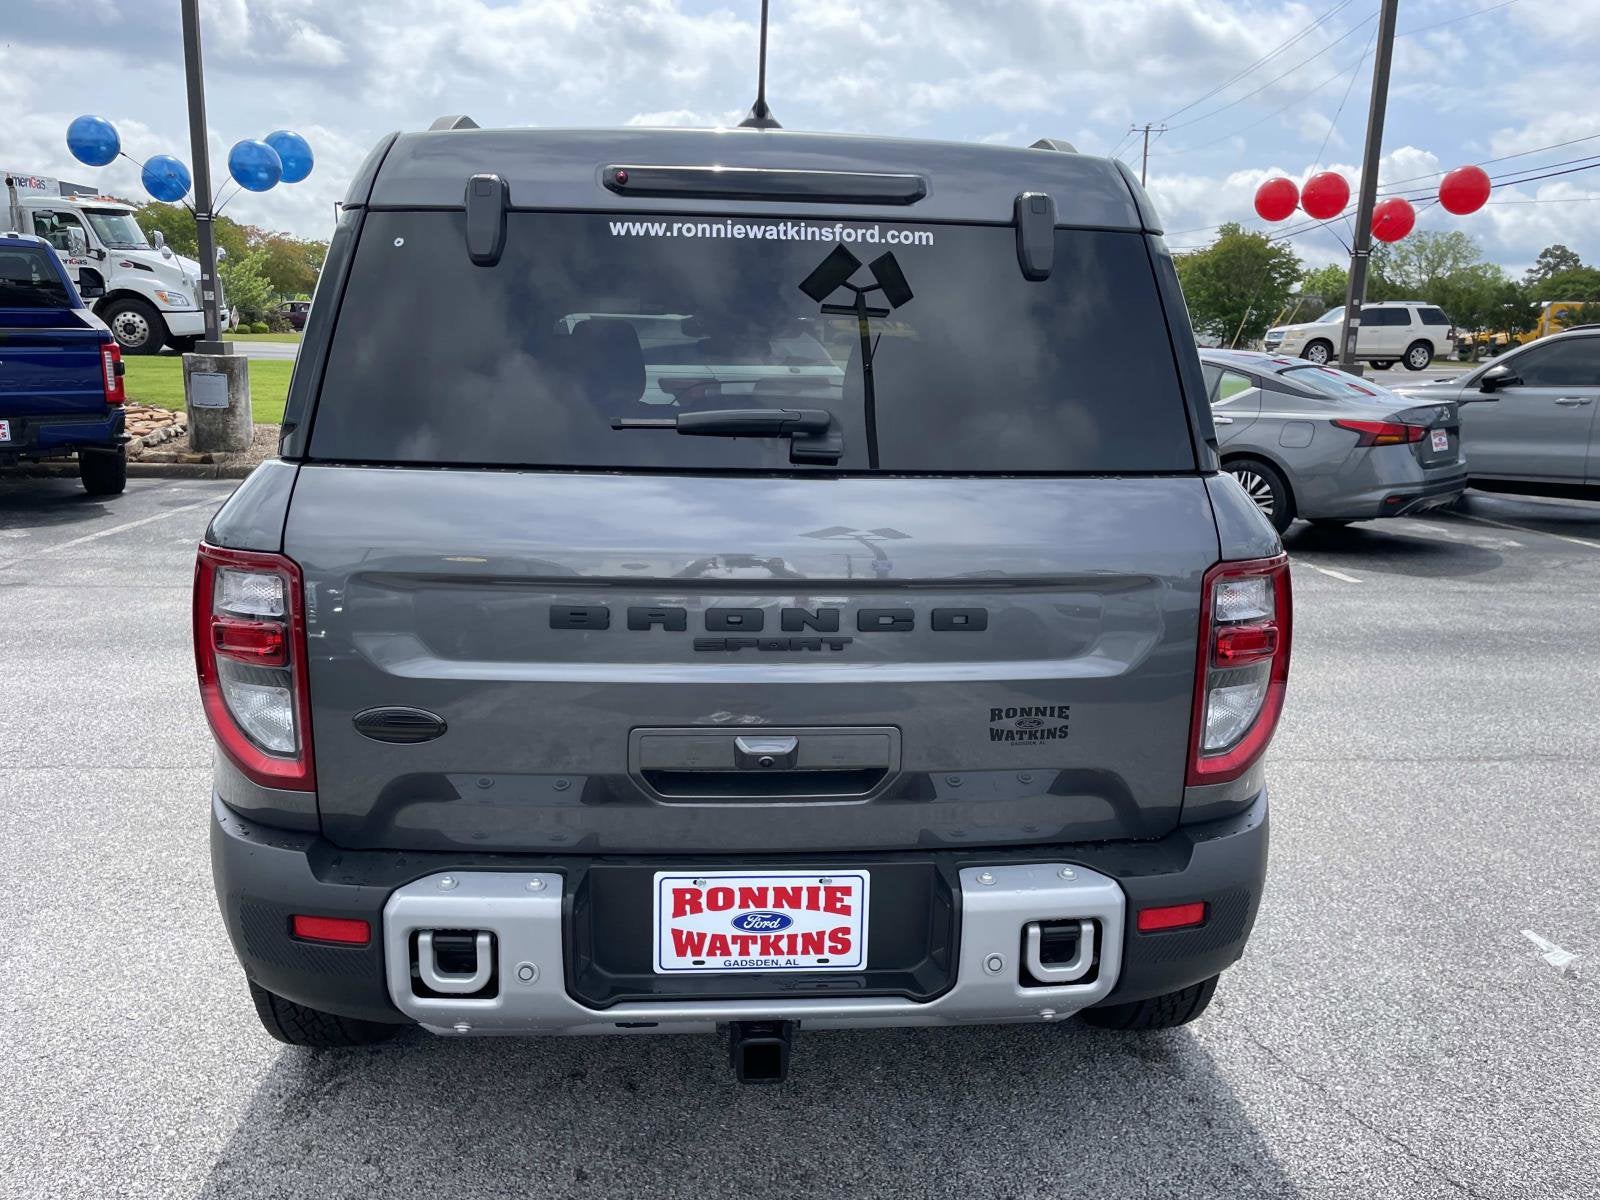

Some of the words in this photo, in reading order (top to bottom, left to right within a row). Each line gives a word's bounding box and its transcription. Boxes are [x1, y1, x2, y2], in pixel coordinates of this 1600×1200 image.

[11, 175, 46, 190] meriGas
[609, 220, 934, 245] www.ronniewatkinsford.com
[549, 605, 988, 632] BRONCO
[693, 636, 853, 652] SPORT
[989, 705, 1070, 722] RONNIE
[989, 725, 1069, 742] WATKINS
[671, 885, 852, 919] RONNIE
[743, 913, 781, 929] Ford
[670, 926, 852, 957] WATKINS
[723, 958, 782, 968] GADSDEN,
[785, 958, 800, 966] AL
